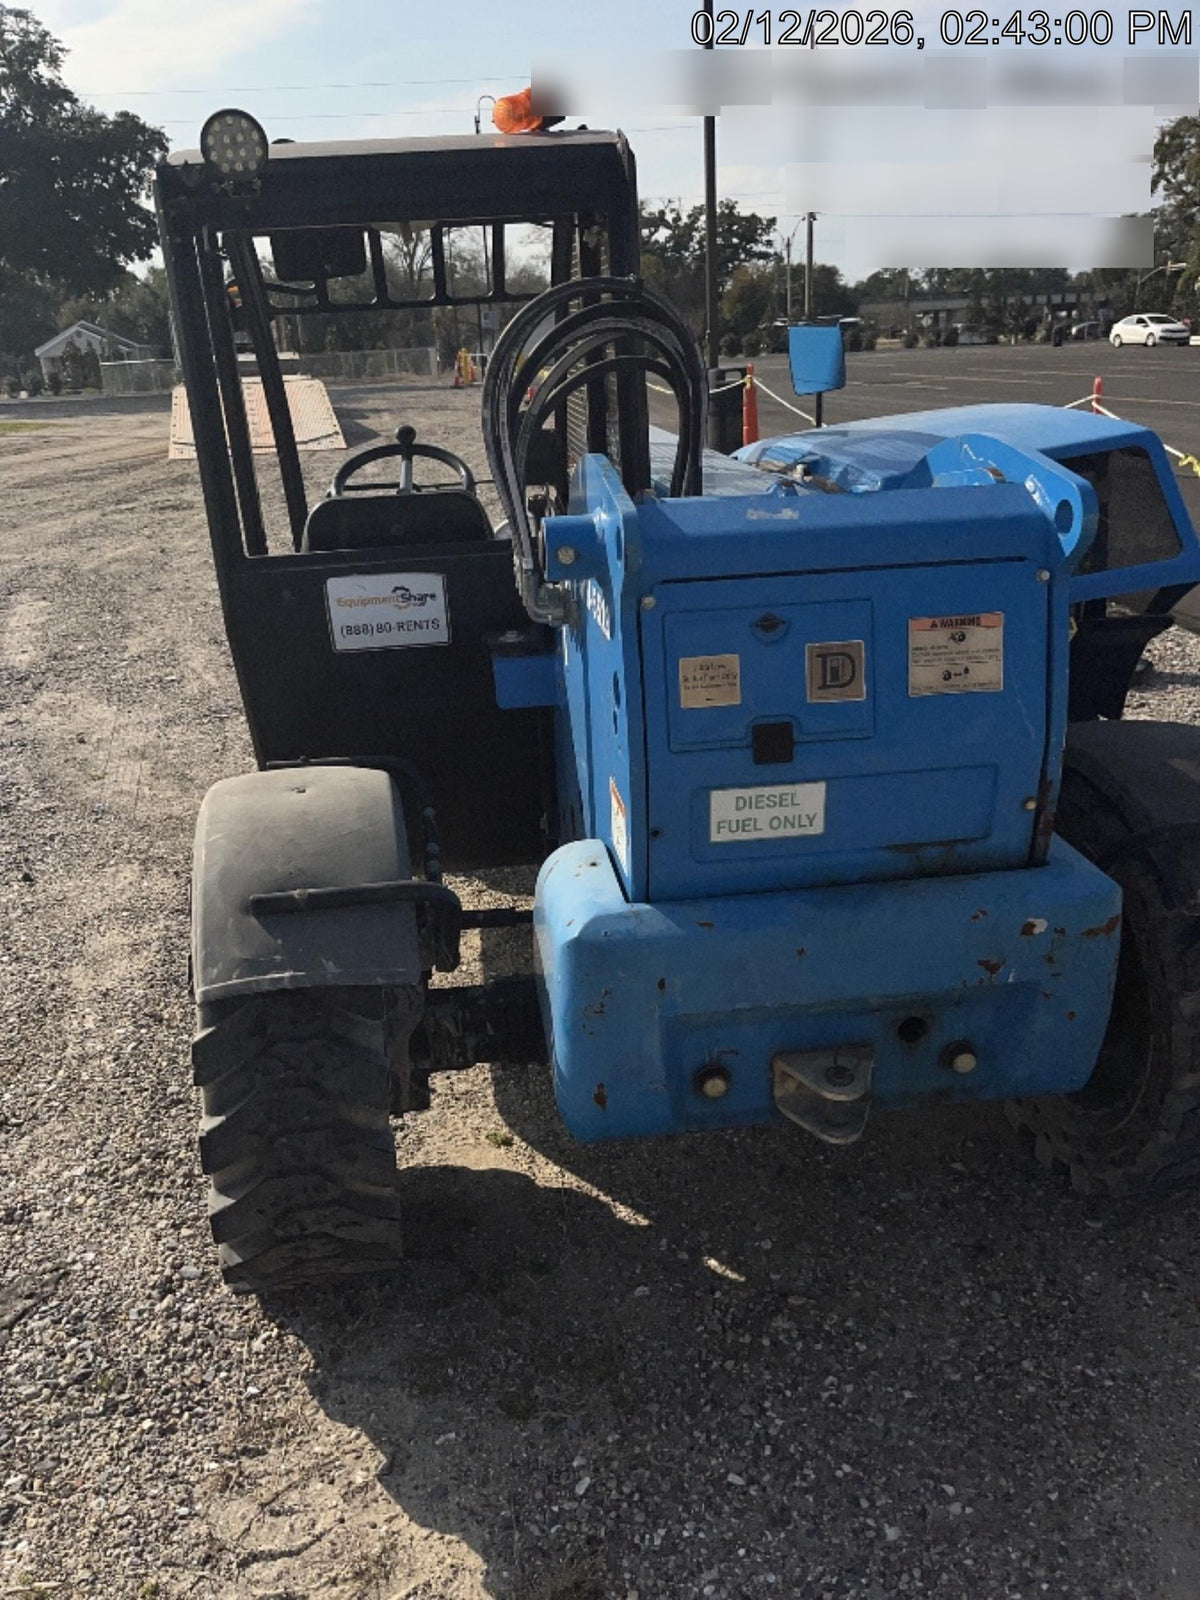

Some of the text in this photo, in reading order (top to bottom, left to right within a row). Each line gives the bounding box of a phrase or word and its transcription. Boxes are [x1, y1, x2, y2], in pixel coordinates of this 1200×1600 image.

[735, 791, 801, 811] DIESEL
[716, 812, 817, 834] FUEL ONLY
